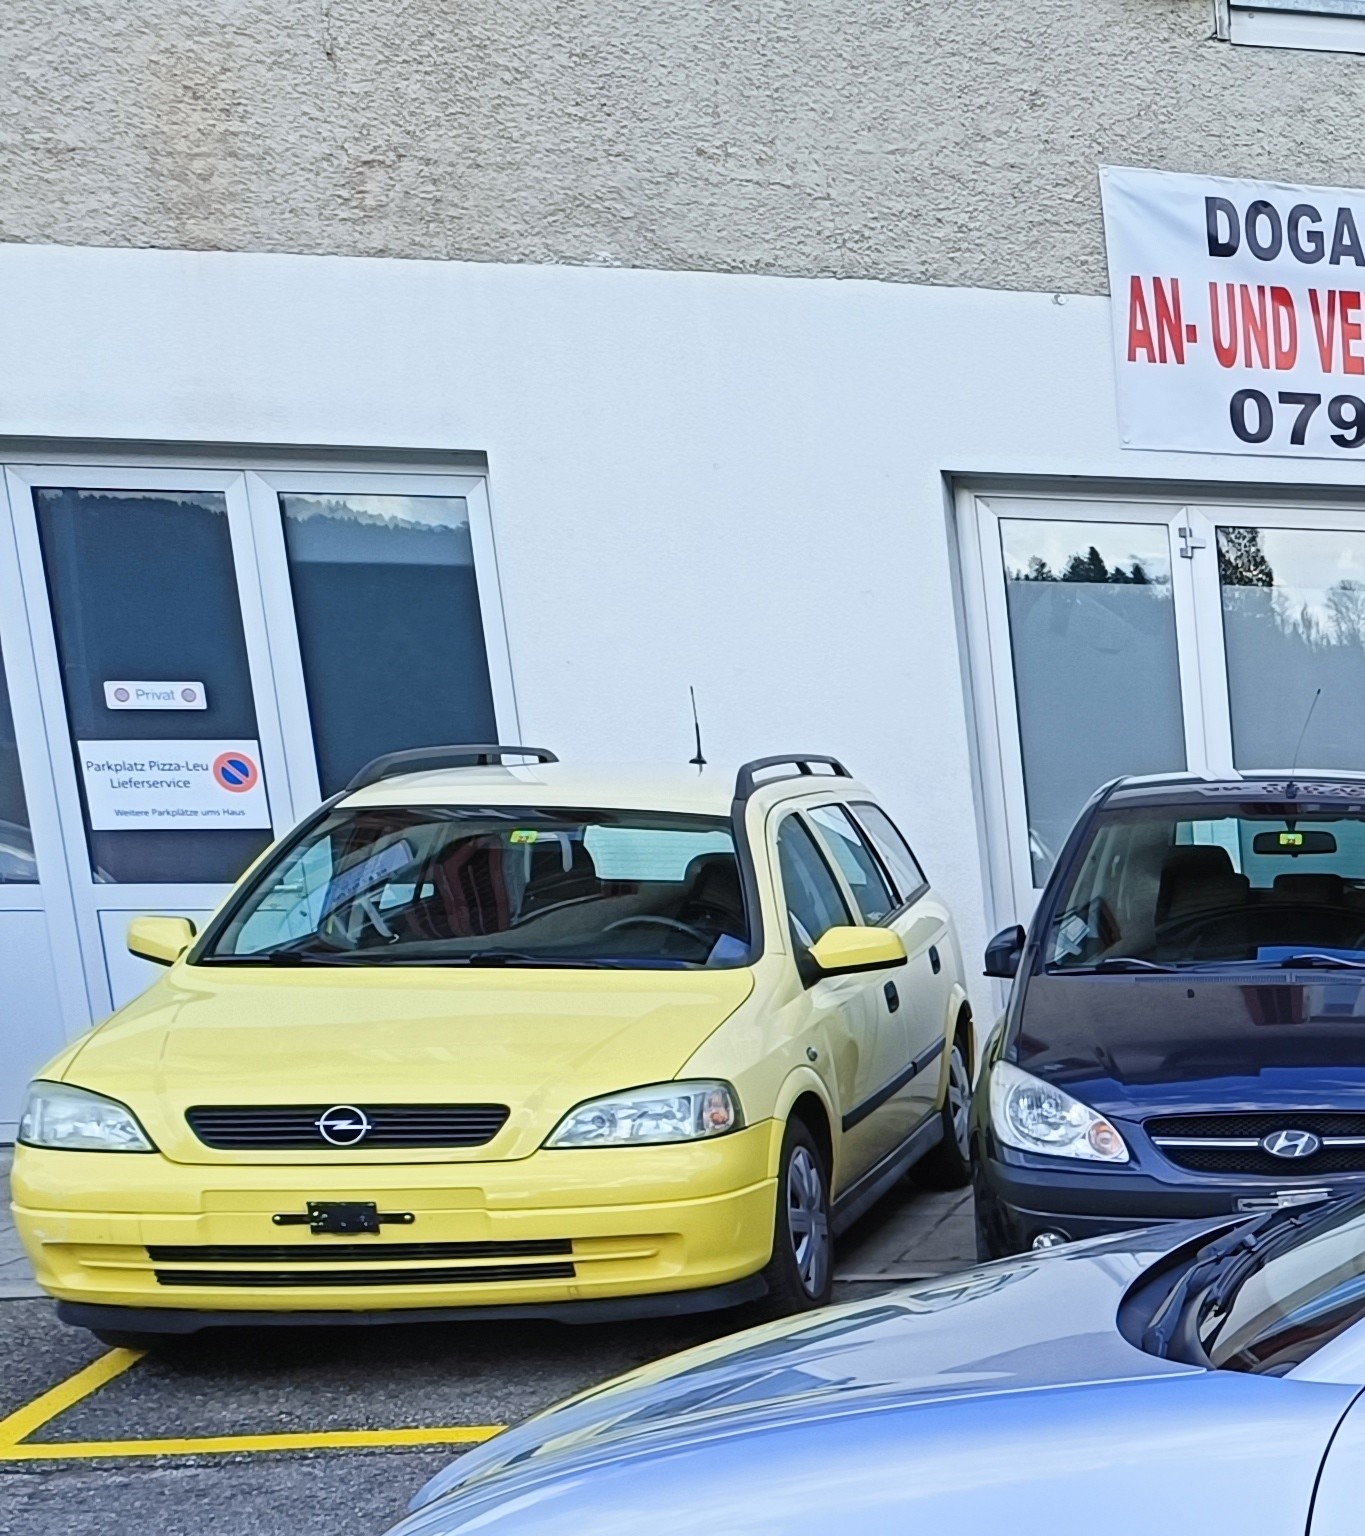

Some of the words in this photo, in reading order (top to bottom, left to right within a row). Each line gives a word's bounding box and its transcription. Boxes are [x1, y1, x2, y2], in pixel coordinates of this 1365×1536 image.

[1127, 275, 1198, 365] AN-
[1208, 281, 1298, 371] UND
[135, 688, 176, 701] Privat
[86, 760, 146, 774] Parkplatz
[148, 760, 209, 772] Pizza-Leu
[110, 777, 191, 789] Lieferservice
[113, 808, 150, 817] Weitere
[151, 808, 199, 818] Parkplätze
[201, 809, 221, 817] ums
[222, 807, 246, 817] Haus
